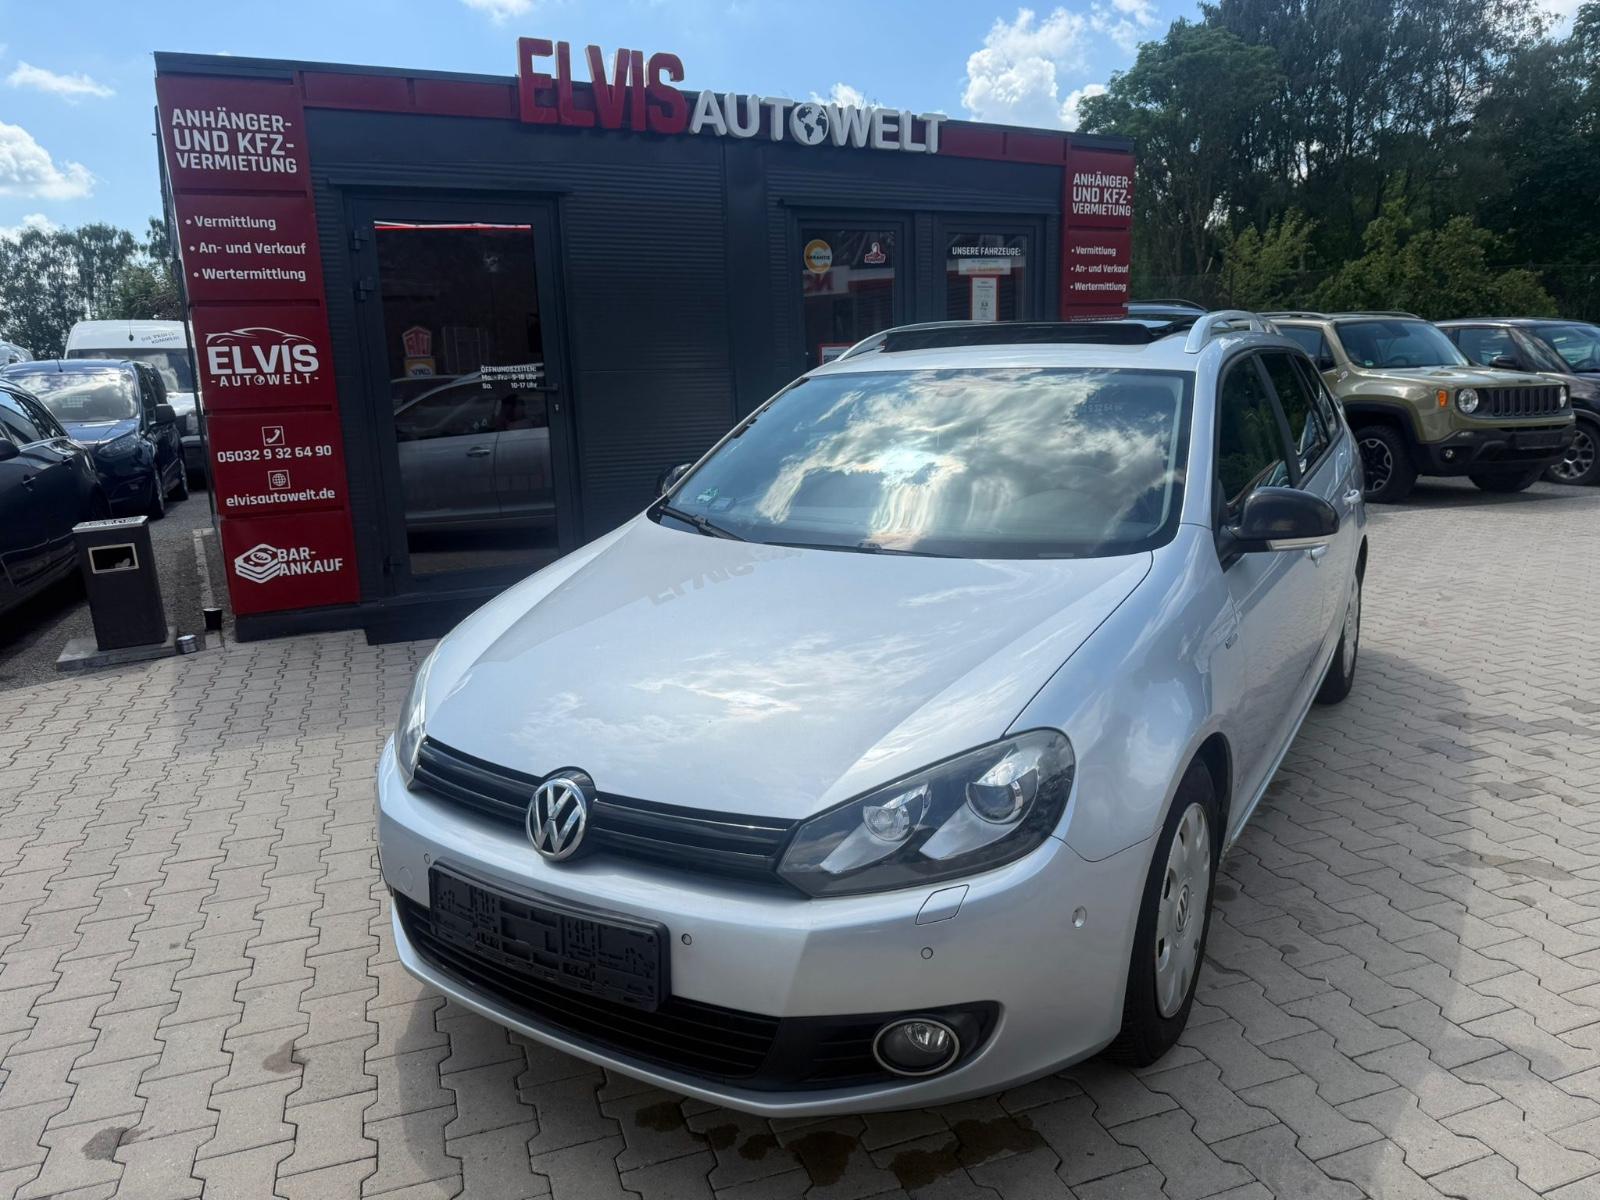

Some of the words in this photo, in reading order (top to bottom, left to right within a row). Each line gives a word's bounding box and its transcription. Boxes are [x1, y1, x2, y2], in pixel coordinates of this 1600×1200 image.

[518, 36, 690, 134] ELVIS
[172, 106, 292, 132] ANHÄNGER-
[174, 128, 229, 152] UND
[238, 132, 294, 155] KFZ-
[176, 152, 297, 173] VERMIETUNG
[1073, 171, 1132, 188] ANHÄNGER-
[1073, 187, 1100, 203] UND
[1103, 189, 1131, 204] KFZ-
[1072, 203, 1131, 216] VERMIETUNG
[194, 216, 277, 231] Vermittlung
[199, 242, 221, 254] An-
[226, 242, 251, 254] und
[255, 243, 307, 255] Verkauf
[952, 246, 979, 256] UNSERE
[1075, 246, 1117, 257] Vermittlung
[202, 268, 307, 282] Wertermittlung
[1075, 264, 1087, 273] An-
[1088, 264, 1102, 273] und
[1103, 264, 1129, 274] Verkauf
[1074, 282, 1127, 293] Wertermittlung
[207, 344, 319, 375] ELVIS
[217, 451, 260, 463] 05032
[263, 449, 272, 460] 9
[276, 448, 292, 459] 32
[295, 446, 312, 458] 64
[315, 445, 332, 456] 90
[226, 488, 336, 507] elvisautowelt.de
[277, 546, 317, 562] BAR-
[279, 558, 343, 576] ANKAUF
